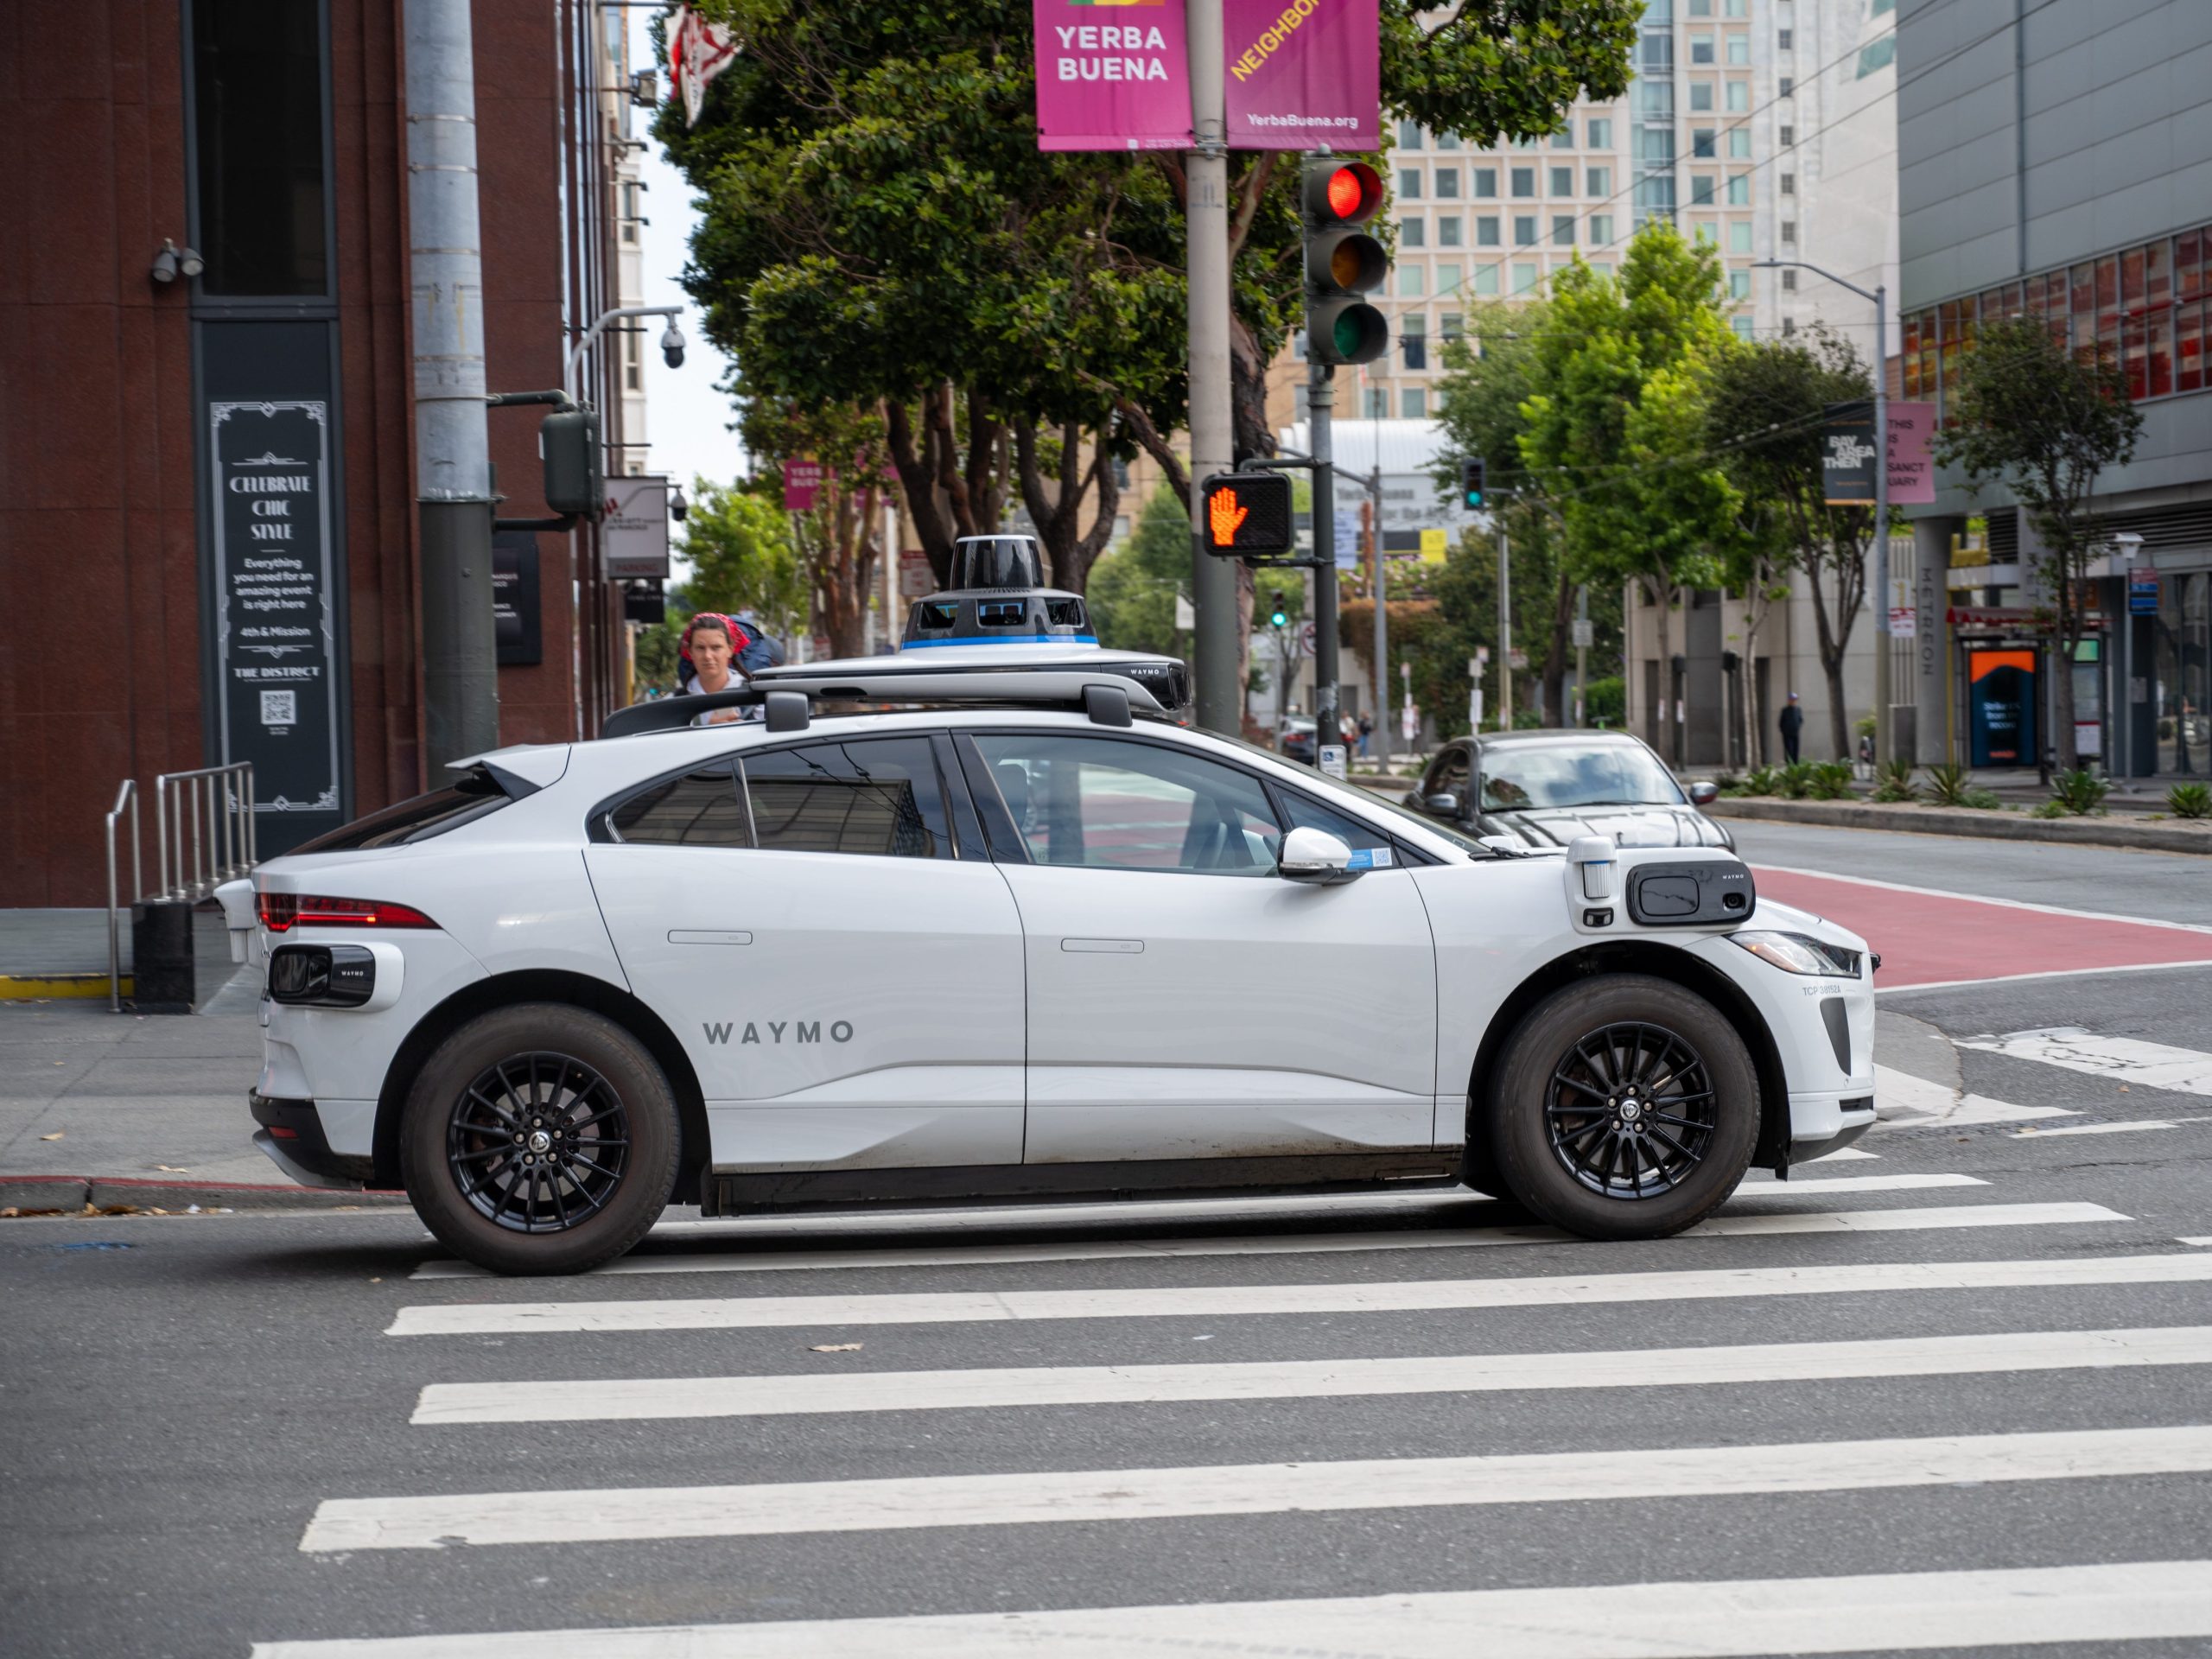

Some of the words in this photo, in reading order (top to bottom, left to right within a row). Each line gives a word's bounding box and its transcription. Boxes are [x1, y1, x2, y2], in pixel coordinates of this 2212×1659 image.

[1055, 26, 1166, 49] YERBA
[1058, 58, 1168, 80] BUENA
[1247, 114, 1358, 129] YerbaBuena.org
[1888, 420, 1914, 429] THIS
[1828, 435, 1857, 448] BAY
[1836, 445, 1876, 458] AREA
[1821, 456, 1862, 469] THEN
[1887, 462, 1925, 473] SANCT
[229, 476, 312, 493] CELEBRATE
[1887, 477, 1918, 486] UARY
[251, 499, 291, 516] CHIC
[251, 524, 294, 539] STYLE
[244, 557, 302, 569] Everything
[232, 574, 254, 584] you
[255, 572, 282, 582] need
[283, 570, 297, 581] for
[235, 586, 281, 597] amazing
[282, 585, 312, 595] event
[243, 600, 253, 609] is
[253, 600, 281, 611] right
[281, 600, 306, 608] here
[1922, 567, 1934, 676] METREON
[240, 627, 259, 637] 4th
[260, 626, 270, 637] &
[270, 626, 311, 637] Mission
[232, 668, 258, 677] THE
[260, 666, 320, 677] DISTRICT
[1802, 986, 1818, 995] TCP
[702, 1020, 854, 1045] WAYMO
